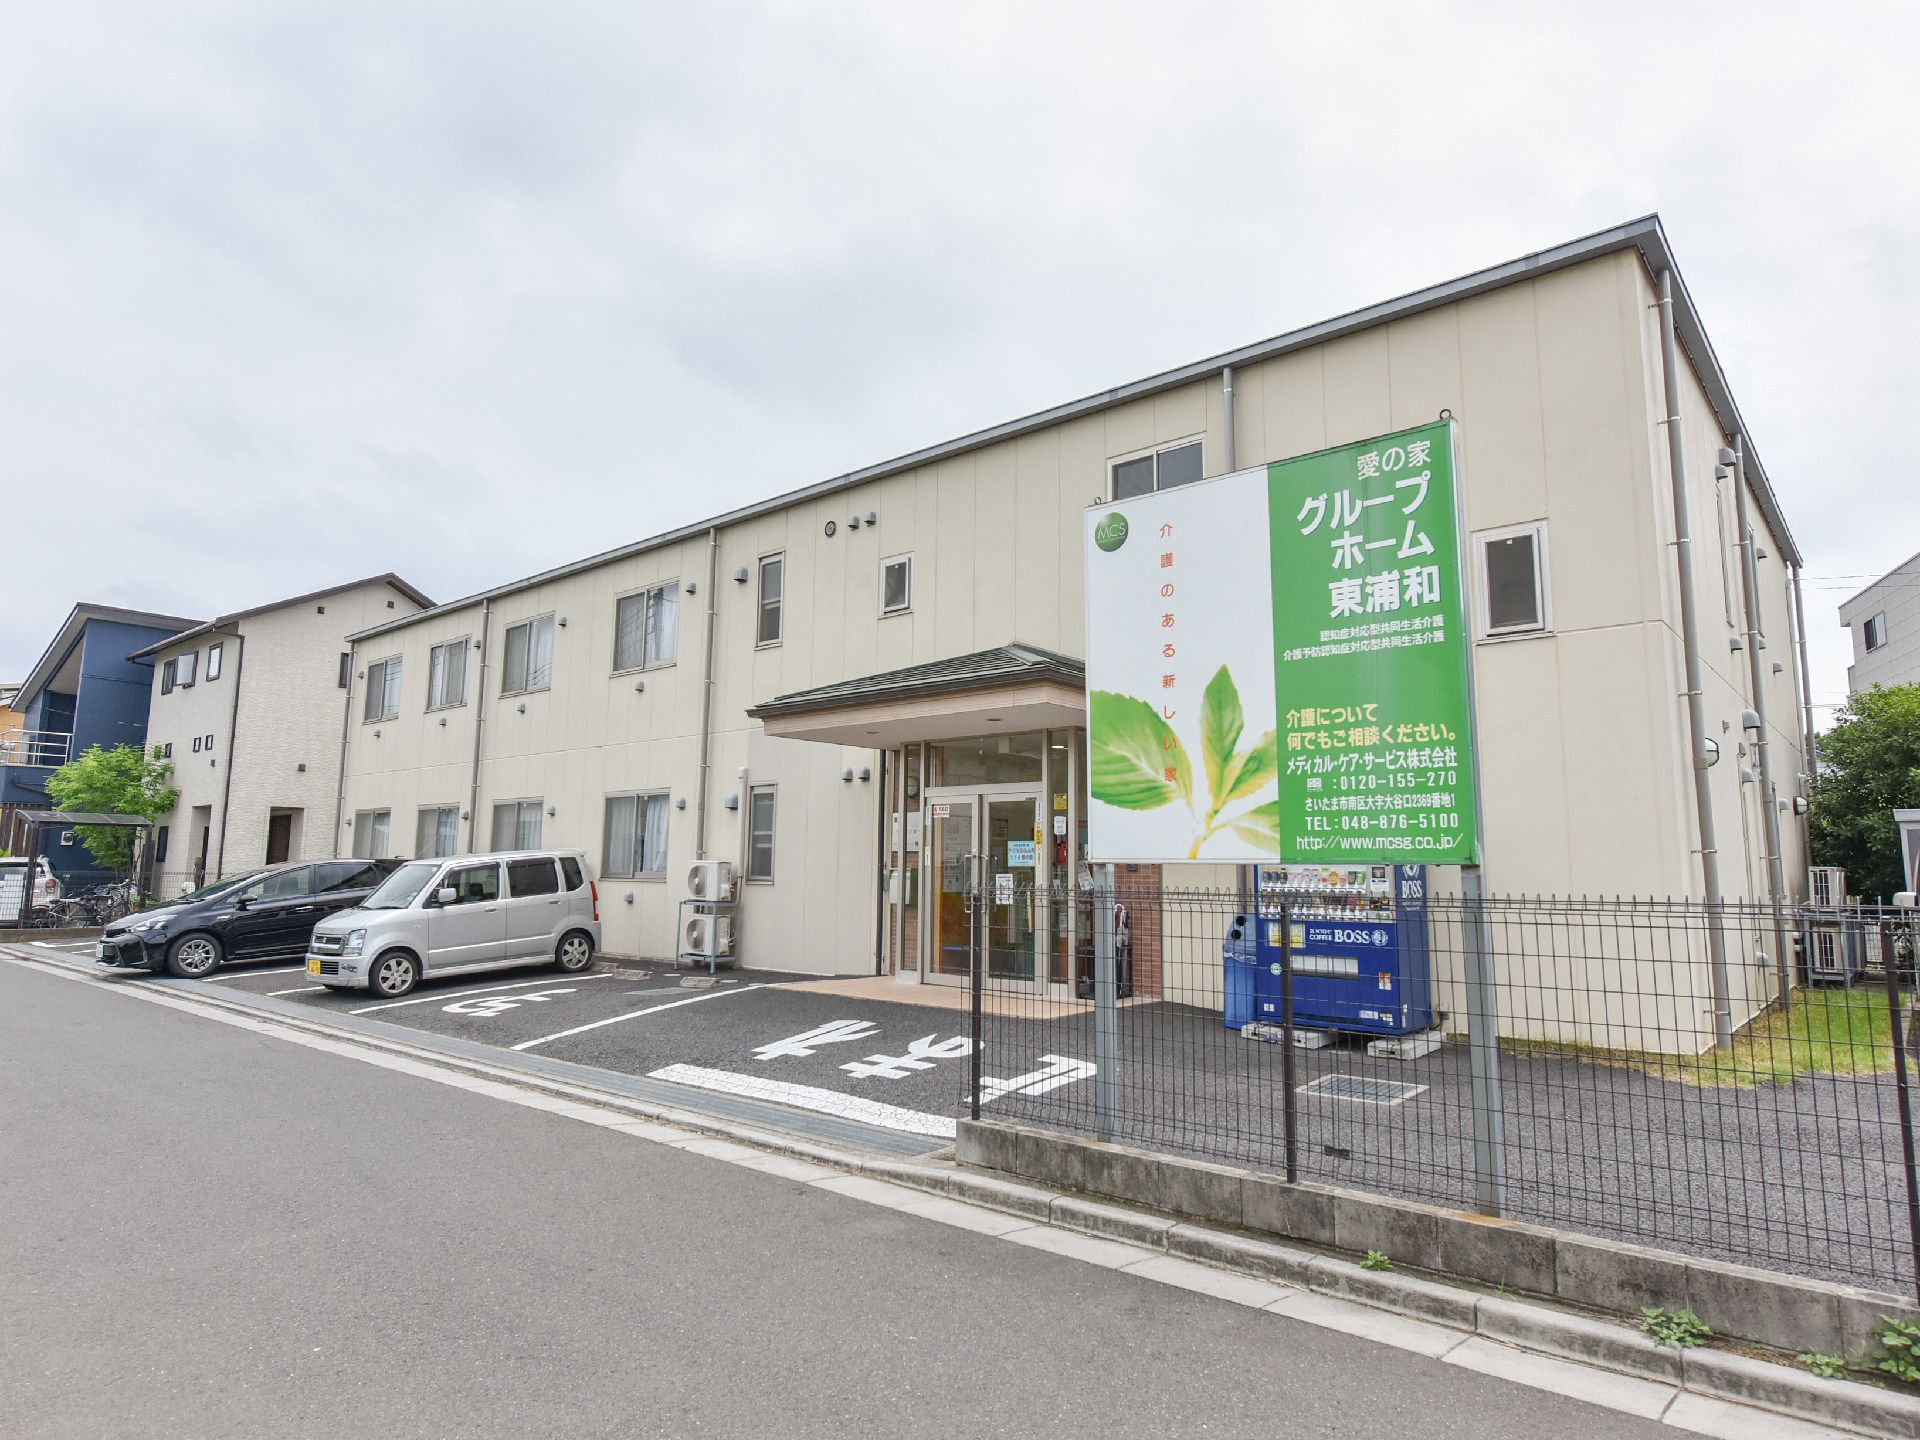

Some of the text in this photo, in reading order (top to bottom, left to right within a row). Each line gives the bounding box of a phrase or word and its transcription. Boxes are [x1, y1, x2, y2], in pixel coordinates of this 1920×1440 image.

[1357, 440, 1431, 480] 愛の家
[1297, 470, 1431, 536] グループ
[1097, 522, 1126, 540] MCS
[1331, 520, 1435, 570] ホーム
[1328, 565, 1441, 619] 東浦和
[1320, 614, 1444, 642] 認知症対応型共同生活介護
[1159, 522, 1177, 783] 介護のある新しい家
[1283, 630, 1445, 661] 介護予防認知症対応型共同生活介護
[1286, 703, 1378, 728] 介護について
[1286, 723, 1456, 751] 何でもご相談ください。
[1296, 833, 1464, 850] http://www.mcsg.co.jp/
[1401, 880, 1423, 899] BOSS
[1333, 929, 1370, 944] BOSS
